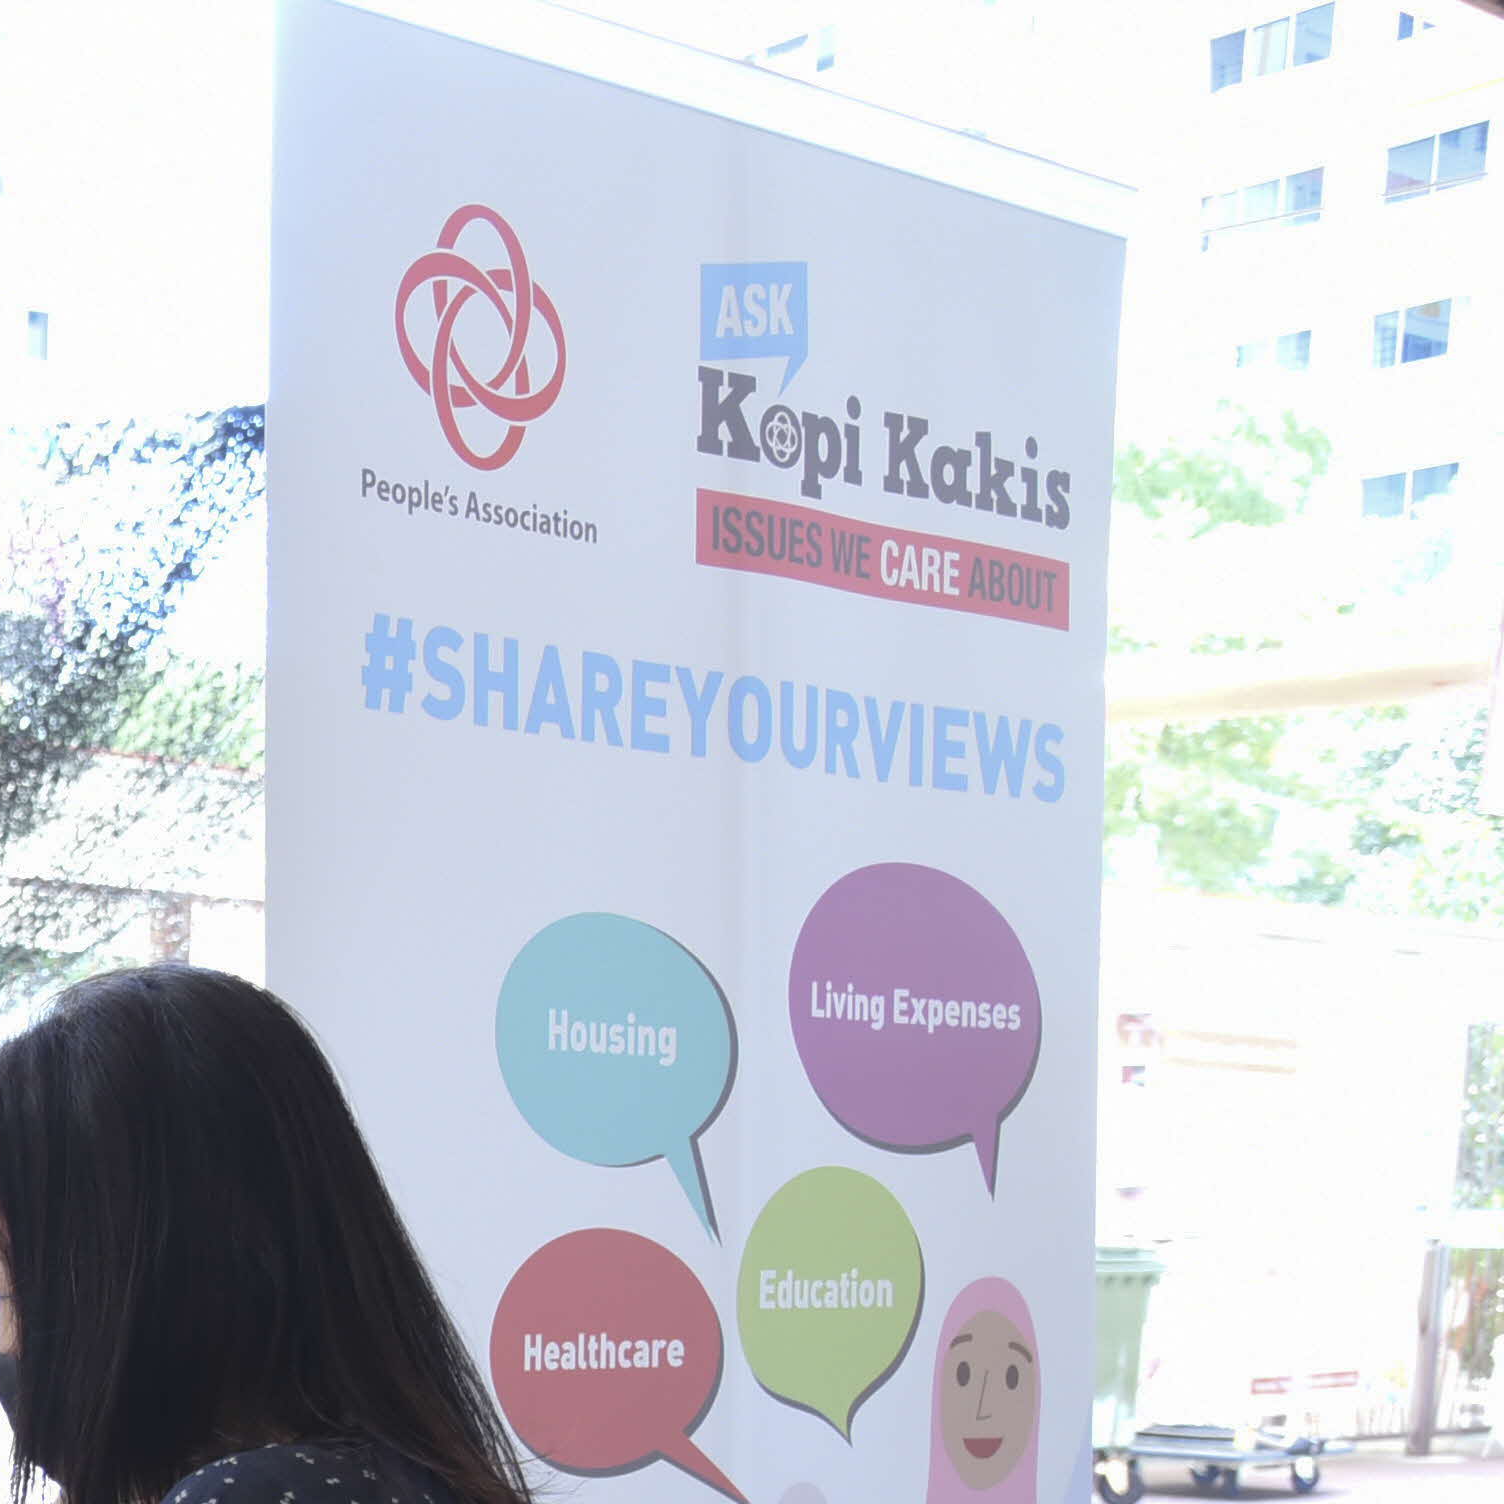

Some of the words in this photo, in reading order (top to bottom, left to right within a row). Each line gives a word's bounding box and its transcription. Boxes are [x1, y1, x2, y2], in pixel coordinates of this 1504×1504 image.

[715, 283, 795, 339] ASK
[697, 365, 862, 499] Kopi
[883, 411, 1070, 531] Kakis
[465, 491, 598, 545] Association
[712, 505, 822, 568] ISSUES
[830, 533, 871, 579] WE
[880, 539, 960, 596] CARE
[968, 556, 1057, 614] ABOUT
[361, 612, 1066, 803] #SHAREYOURVIEWS
[810, 981, 885, 1032] Living
[893, 988, 1022, 1035] Expenses
[547, 1008, 678, 1066] Housing
[759, 1269, 894, 1311] Education
[523, 1333, 685, 1373] Healthcare
